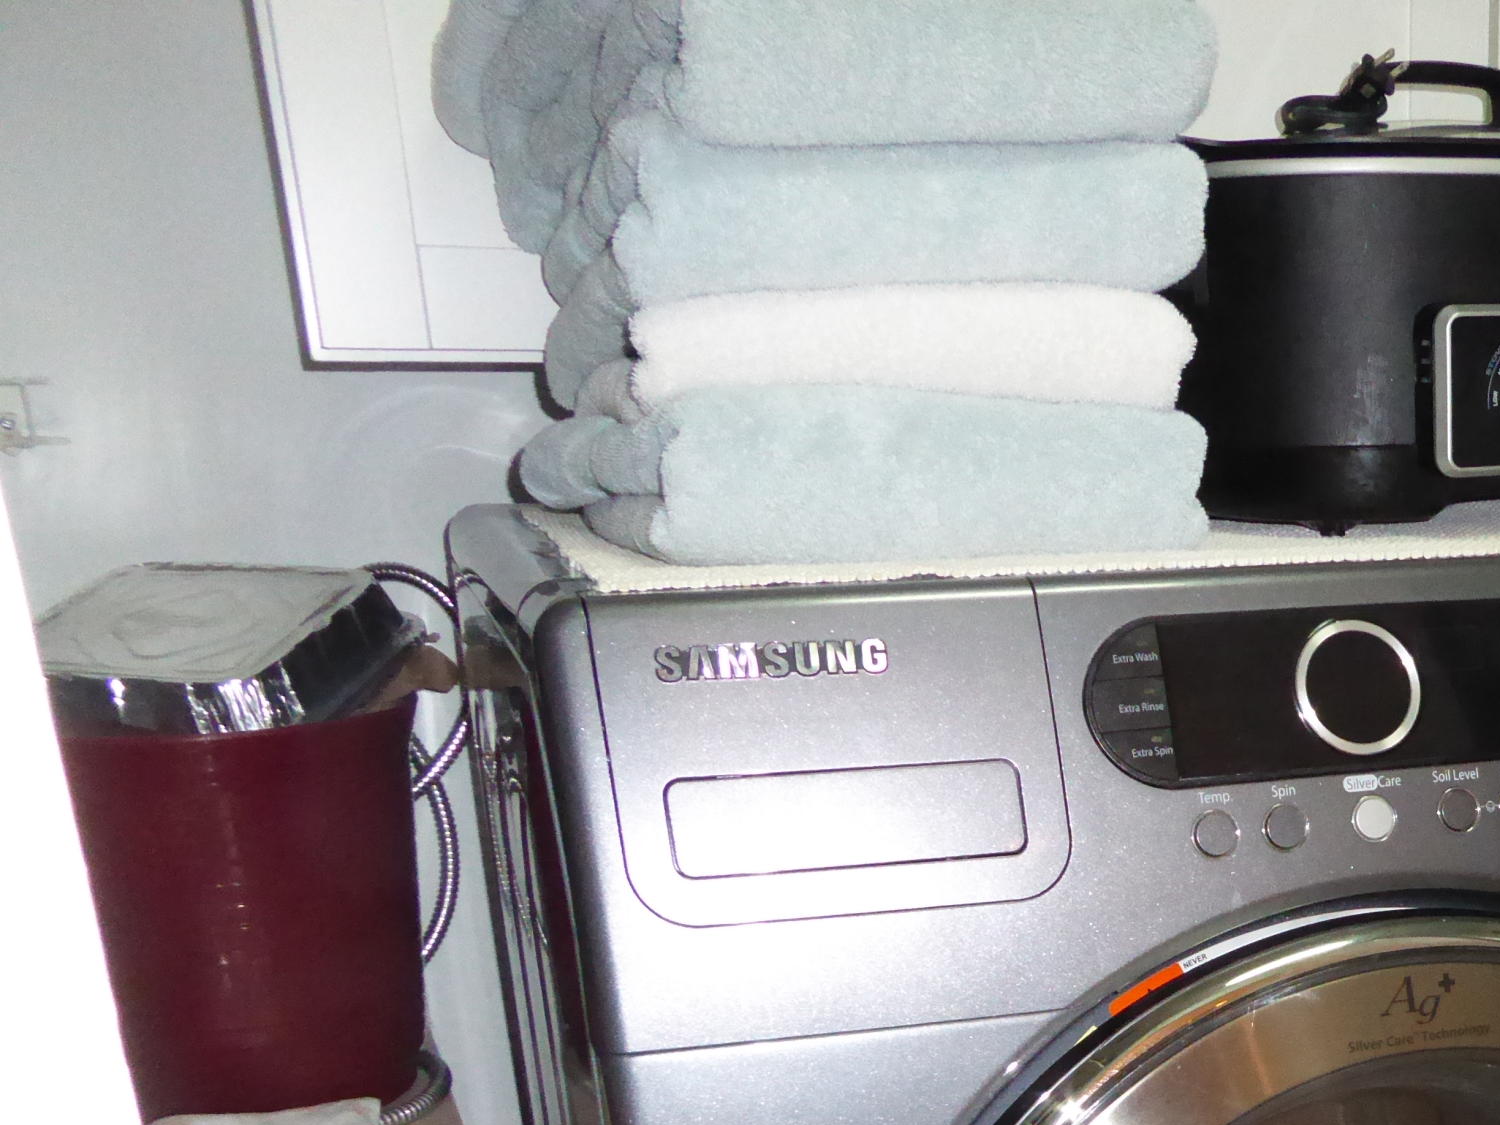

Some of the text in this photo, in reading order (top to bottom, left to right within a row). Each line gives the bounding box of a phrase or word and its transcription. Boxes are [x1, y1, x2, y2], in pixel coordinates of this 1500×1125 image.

[652, 636, 890, 684] SAMSUNG
[1112, 651, 1159, 664] Extra Wash
[1118, 701, 1165, 714] Extra Rinse
[1131, 745, 1174, 759] Extra Spin
[1431, 767, 1479, 783] Soil Level
[1270, 784, 1297, 800] Spin
[1182, 953, 1208, 969] NEVER
[1347, 1039, 1386, 1053] Silver
[1421, 1023, 1491, 1043] Technology
